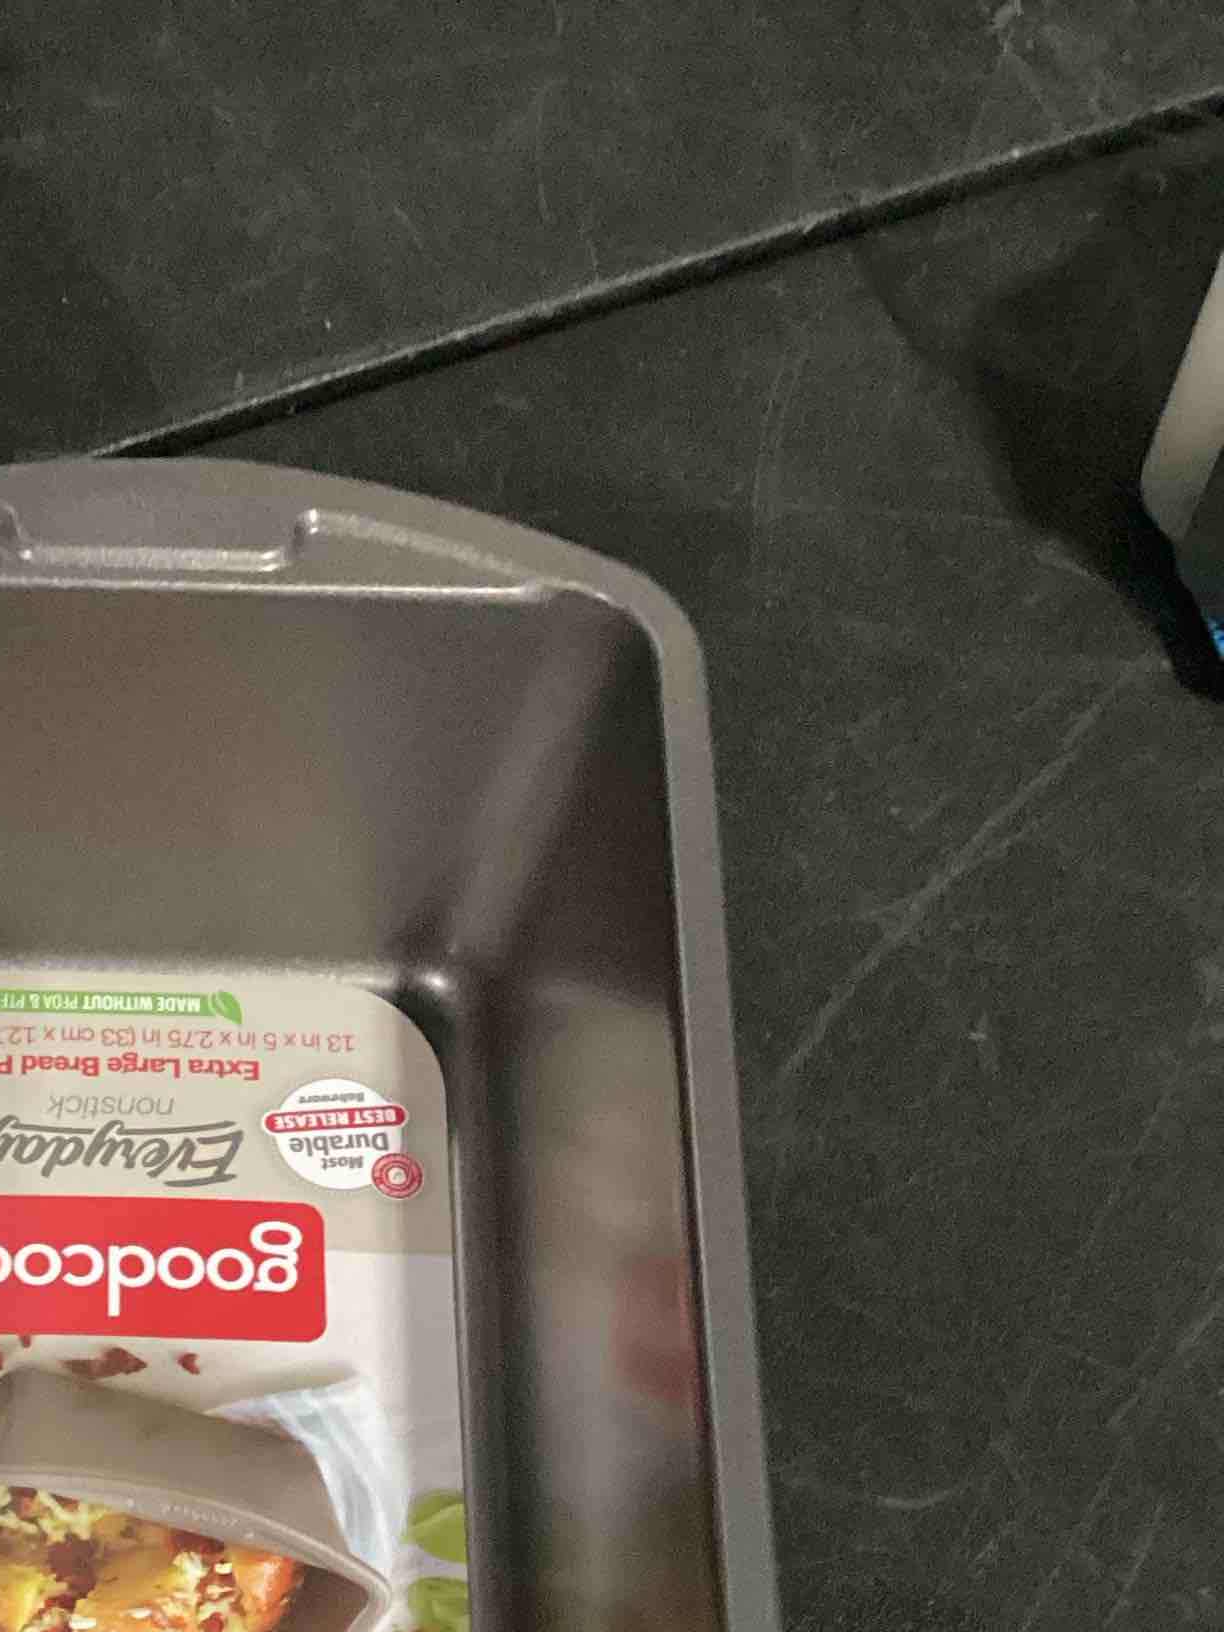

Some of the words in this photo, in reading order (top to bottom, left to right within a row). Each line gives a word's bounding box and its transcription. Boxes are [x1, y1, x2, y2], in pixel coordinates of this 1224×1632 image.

[29, 993, 40, 1009] &
[43, 994, 78, 1009] PFOA
[83, 994, 153, 1012] WITHOUT
[156, 997, 201, 1012] MADE
[43, 1026, 56, 1041] x
[61, 1027, 95, 1042] cm
[102, 1026, 136, 1048] (33
[142, 1029, 161, 1048] in
[167, 1030, 214, 1049] 2.75
[218, 1031, 232, 1045] x
[238, 1031, 256, 1050] in
[263, 1032, 277, 1050] 5
[283, 1033, 297, 1047] x
[303, 1033, 320, 1051] in
[327, 1033, 355, 1052] 13
[21, 1054, 101, 1077] Bread
[107, 1052, 181, 1080] Large
[189, 1059, 260, 1082] Extra
[47, 1096, 174, 1120] nonstick
[352, 1109, 397, 1124] BEST
[274, 1111, 349, 1129] RELEASE
[289, 1132, 389, 1156] Durable
[320, 1156, 363, 1171] Most
